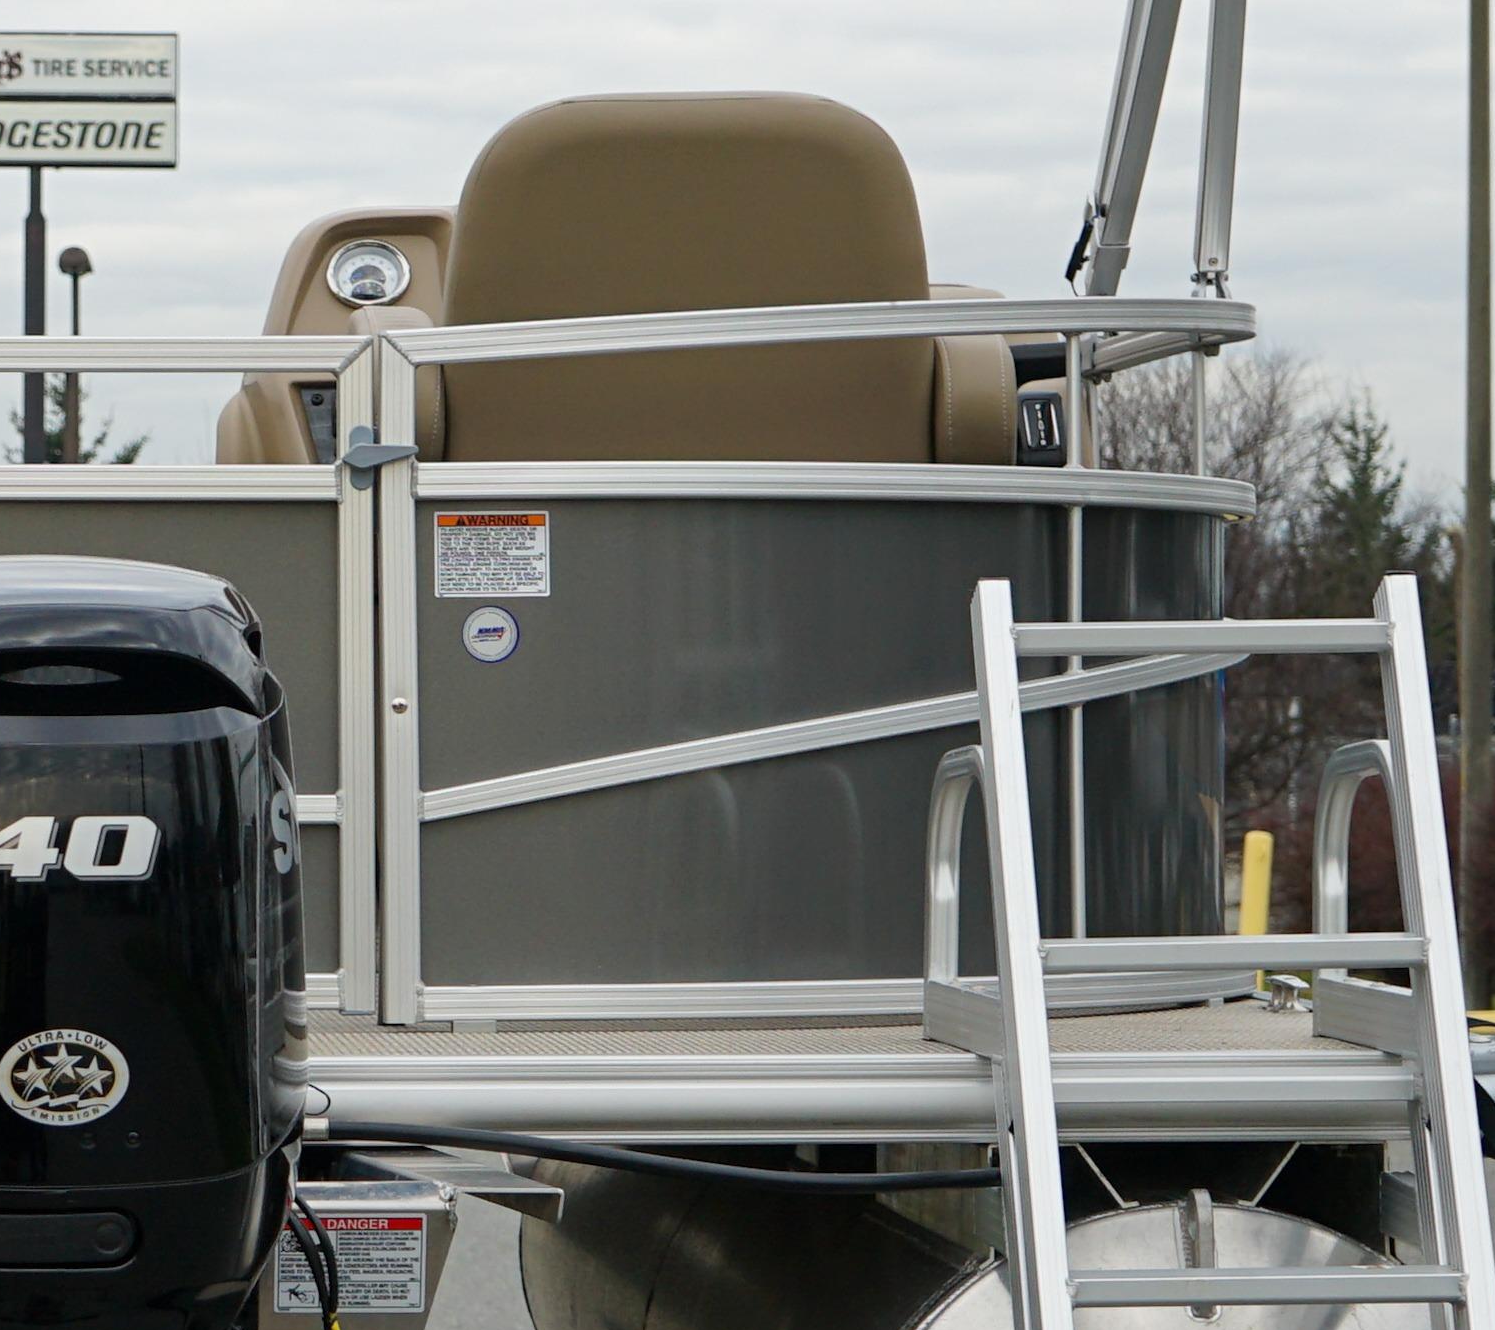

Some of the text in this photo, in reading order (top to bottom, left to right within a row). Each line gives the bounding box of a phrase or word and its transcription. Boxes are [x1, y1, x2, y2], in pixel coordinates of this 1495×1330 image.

[31, 57, 171, 79] TIRE SERVICE
[469, 514, 530, 526] WARNING
[30, 1107, 100, 1122] EMISSION
[326, 1218, 390, 1230] DANGER
